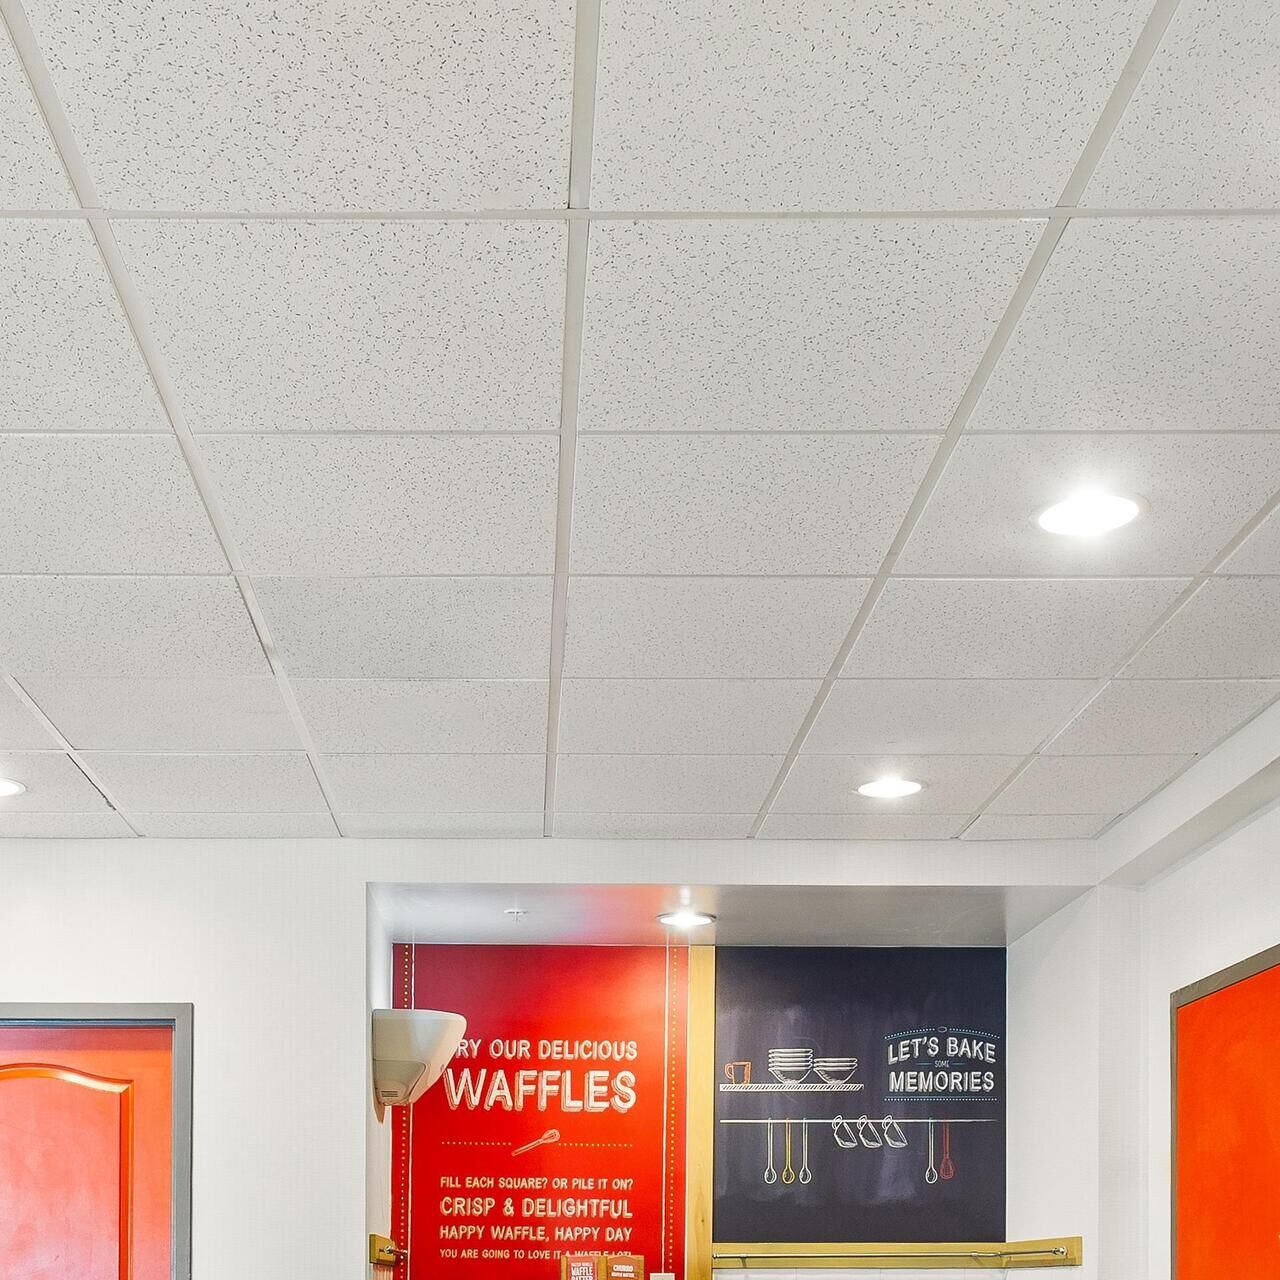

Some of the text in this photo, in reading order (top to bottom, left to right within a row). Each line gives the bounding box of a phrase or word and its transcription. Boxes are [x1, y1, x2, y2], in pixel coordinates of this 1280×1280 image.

[455, 1038, 638, 1062] RY OUR DELICIOUS
[887, 1036, 997, 1065] LET'S BAKE
[442, 1068, 638, 1113] WAFFLES
[888, 1071, 995, 1093] MEMORIES
[440, 1176, 634, 1191] FILL EACH SQUARE? OR PILE IT ON?
[440, 1196, 633, 1219] CRISP & DELIGHTFUL
[440, 1225, 633, 1243] HAPPY WAFFLE, HAPPY DAY
[440, 1249, 458, 1258] YOU
[461, 1249, 479, 1259] ARE
[482, 1249, 510, 1259] GOING
[513, 1249, 525, 1259] TO
[528, 1250, 550, 1260] LOVE
[553, 1250, 561, 1260] IT
[571, 1266, 593, 1276] WAFFLE
